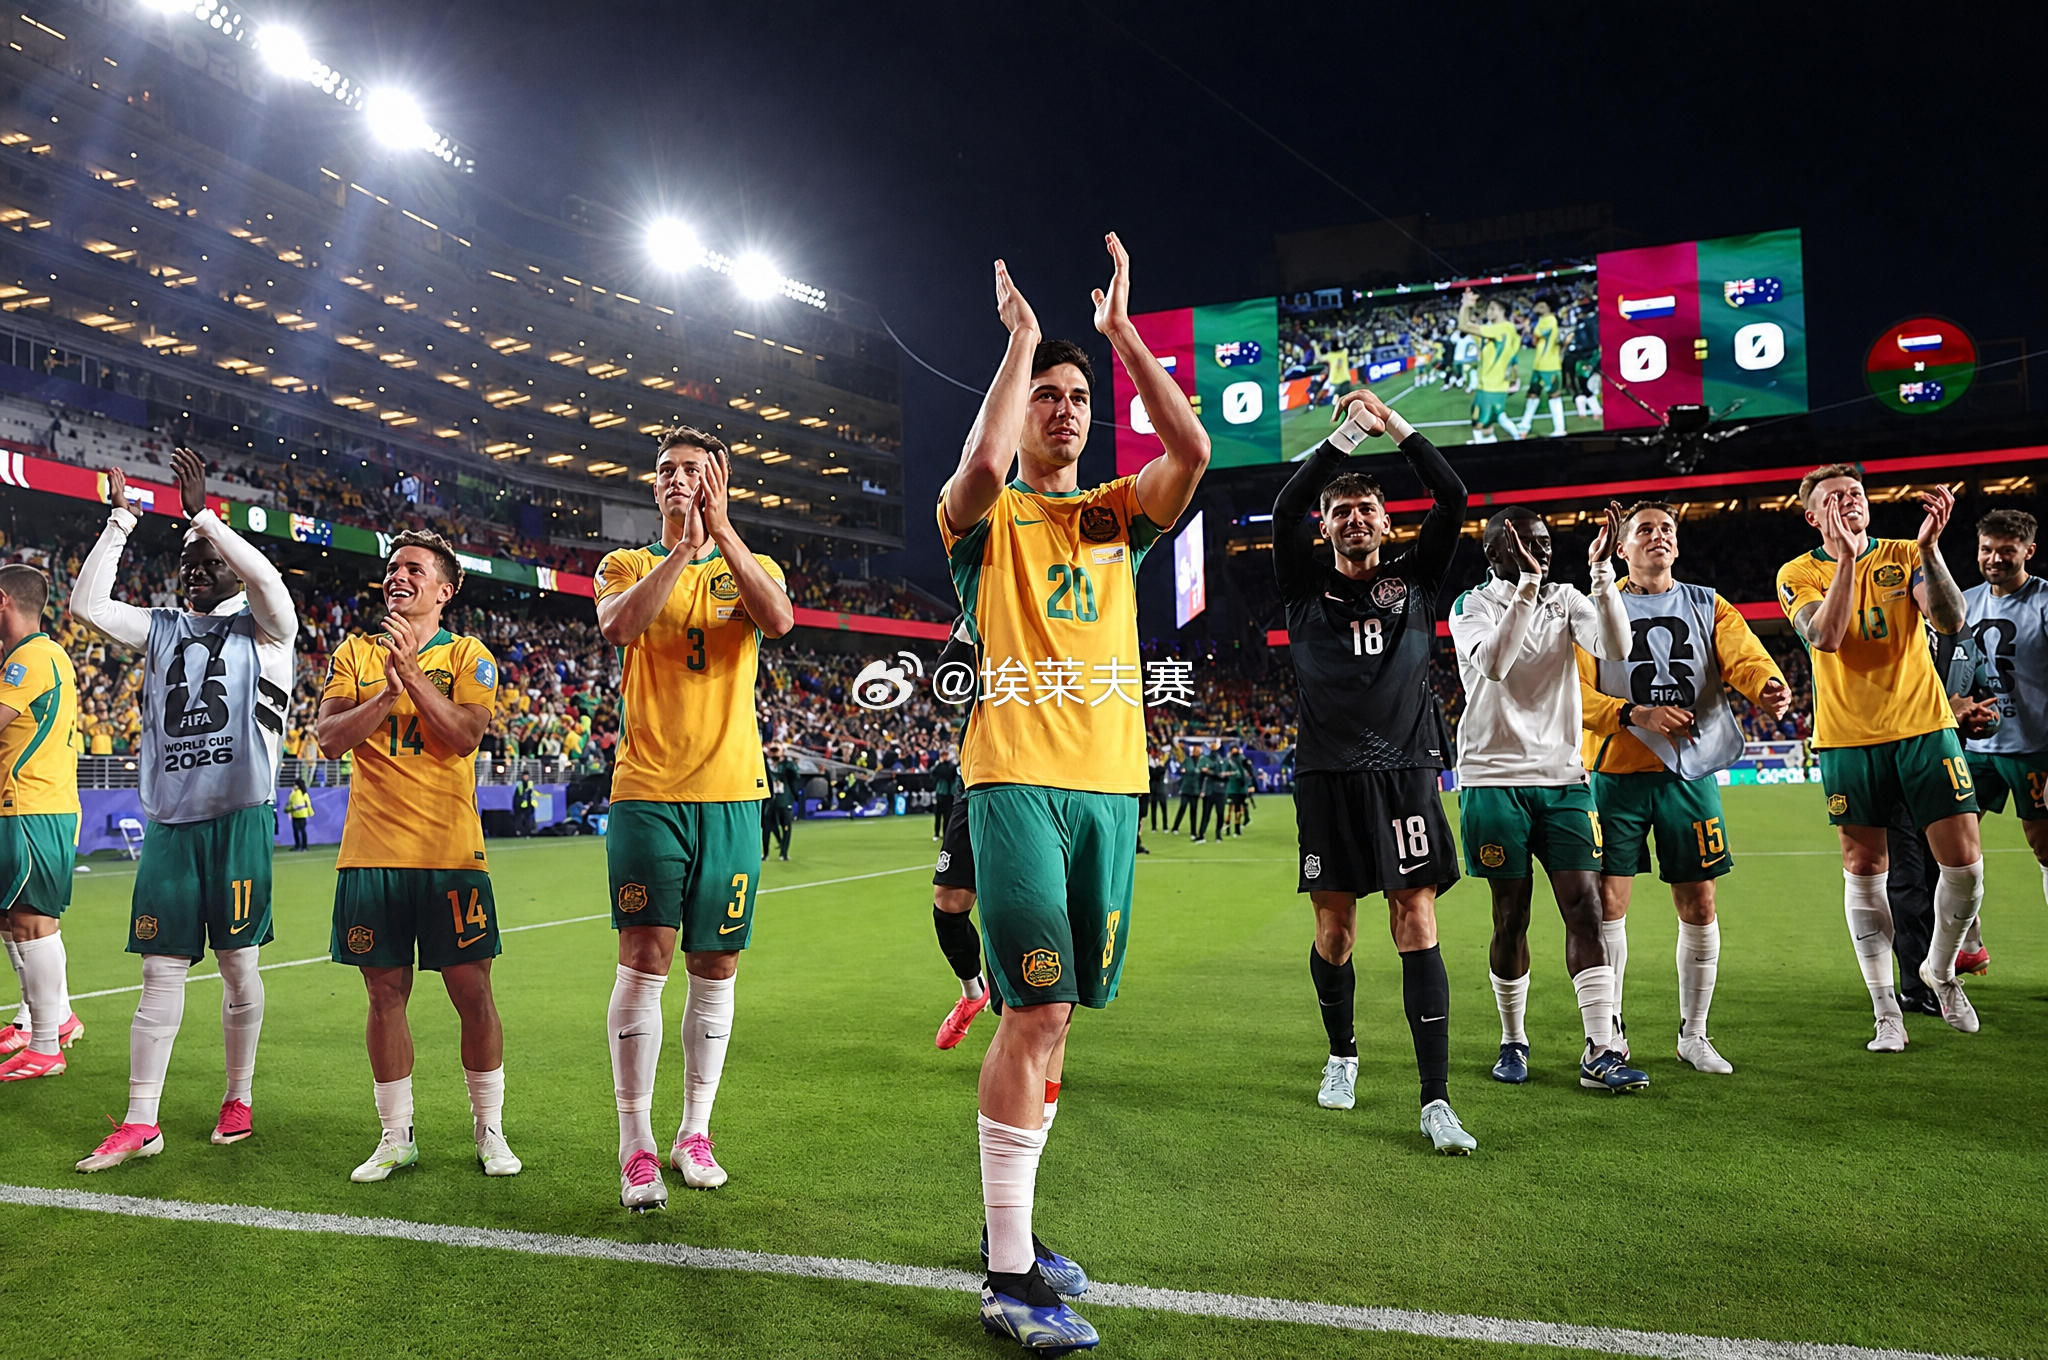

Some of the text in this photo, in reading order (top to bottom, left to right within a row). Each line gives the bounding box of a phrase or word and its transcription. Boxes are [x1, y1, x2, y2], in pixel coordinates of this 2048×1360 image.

[1047, 564, 1099, 622] 20
[1350, 618, 1383, 655] 18
[1858, 606, 1889, 641] 19
[687, 627, 706, 671] 3
[1650, 689, 1683, 701] FIFA
[180, 712, 212, 729] FIFA
[388, 715, 424, 756] 14
[164, 736, 233, 753] WORLD CUP
[165, 748, 233, 772] 2026
[1942, 756, 1972, 790] 19
[1392, 815, 1429, 859] 18
[1693, 816, 1724, 856] 15
[232, 879, 252, 921] 11
[447, 888, 487, 934] 14
[727, 873, 748, 918] 3
